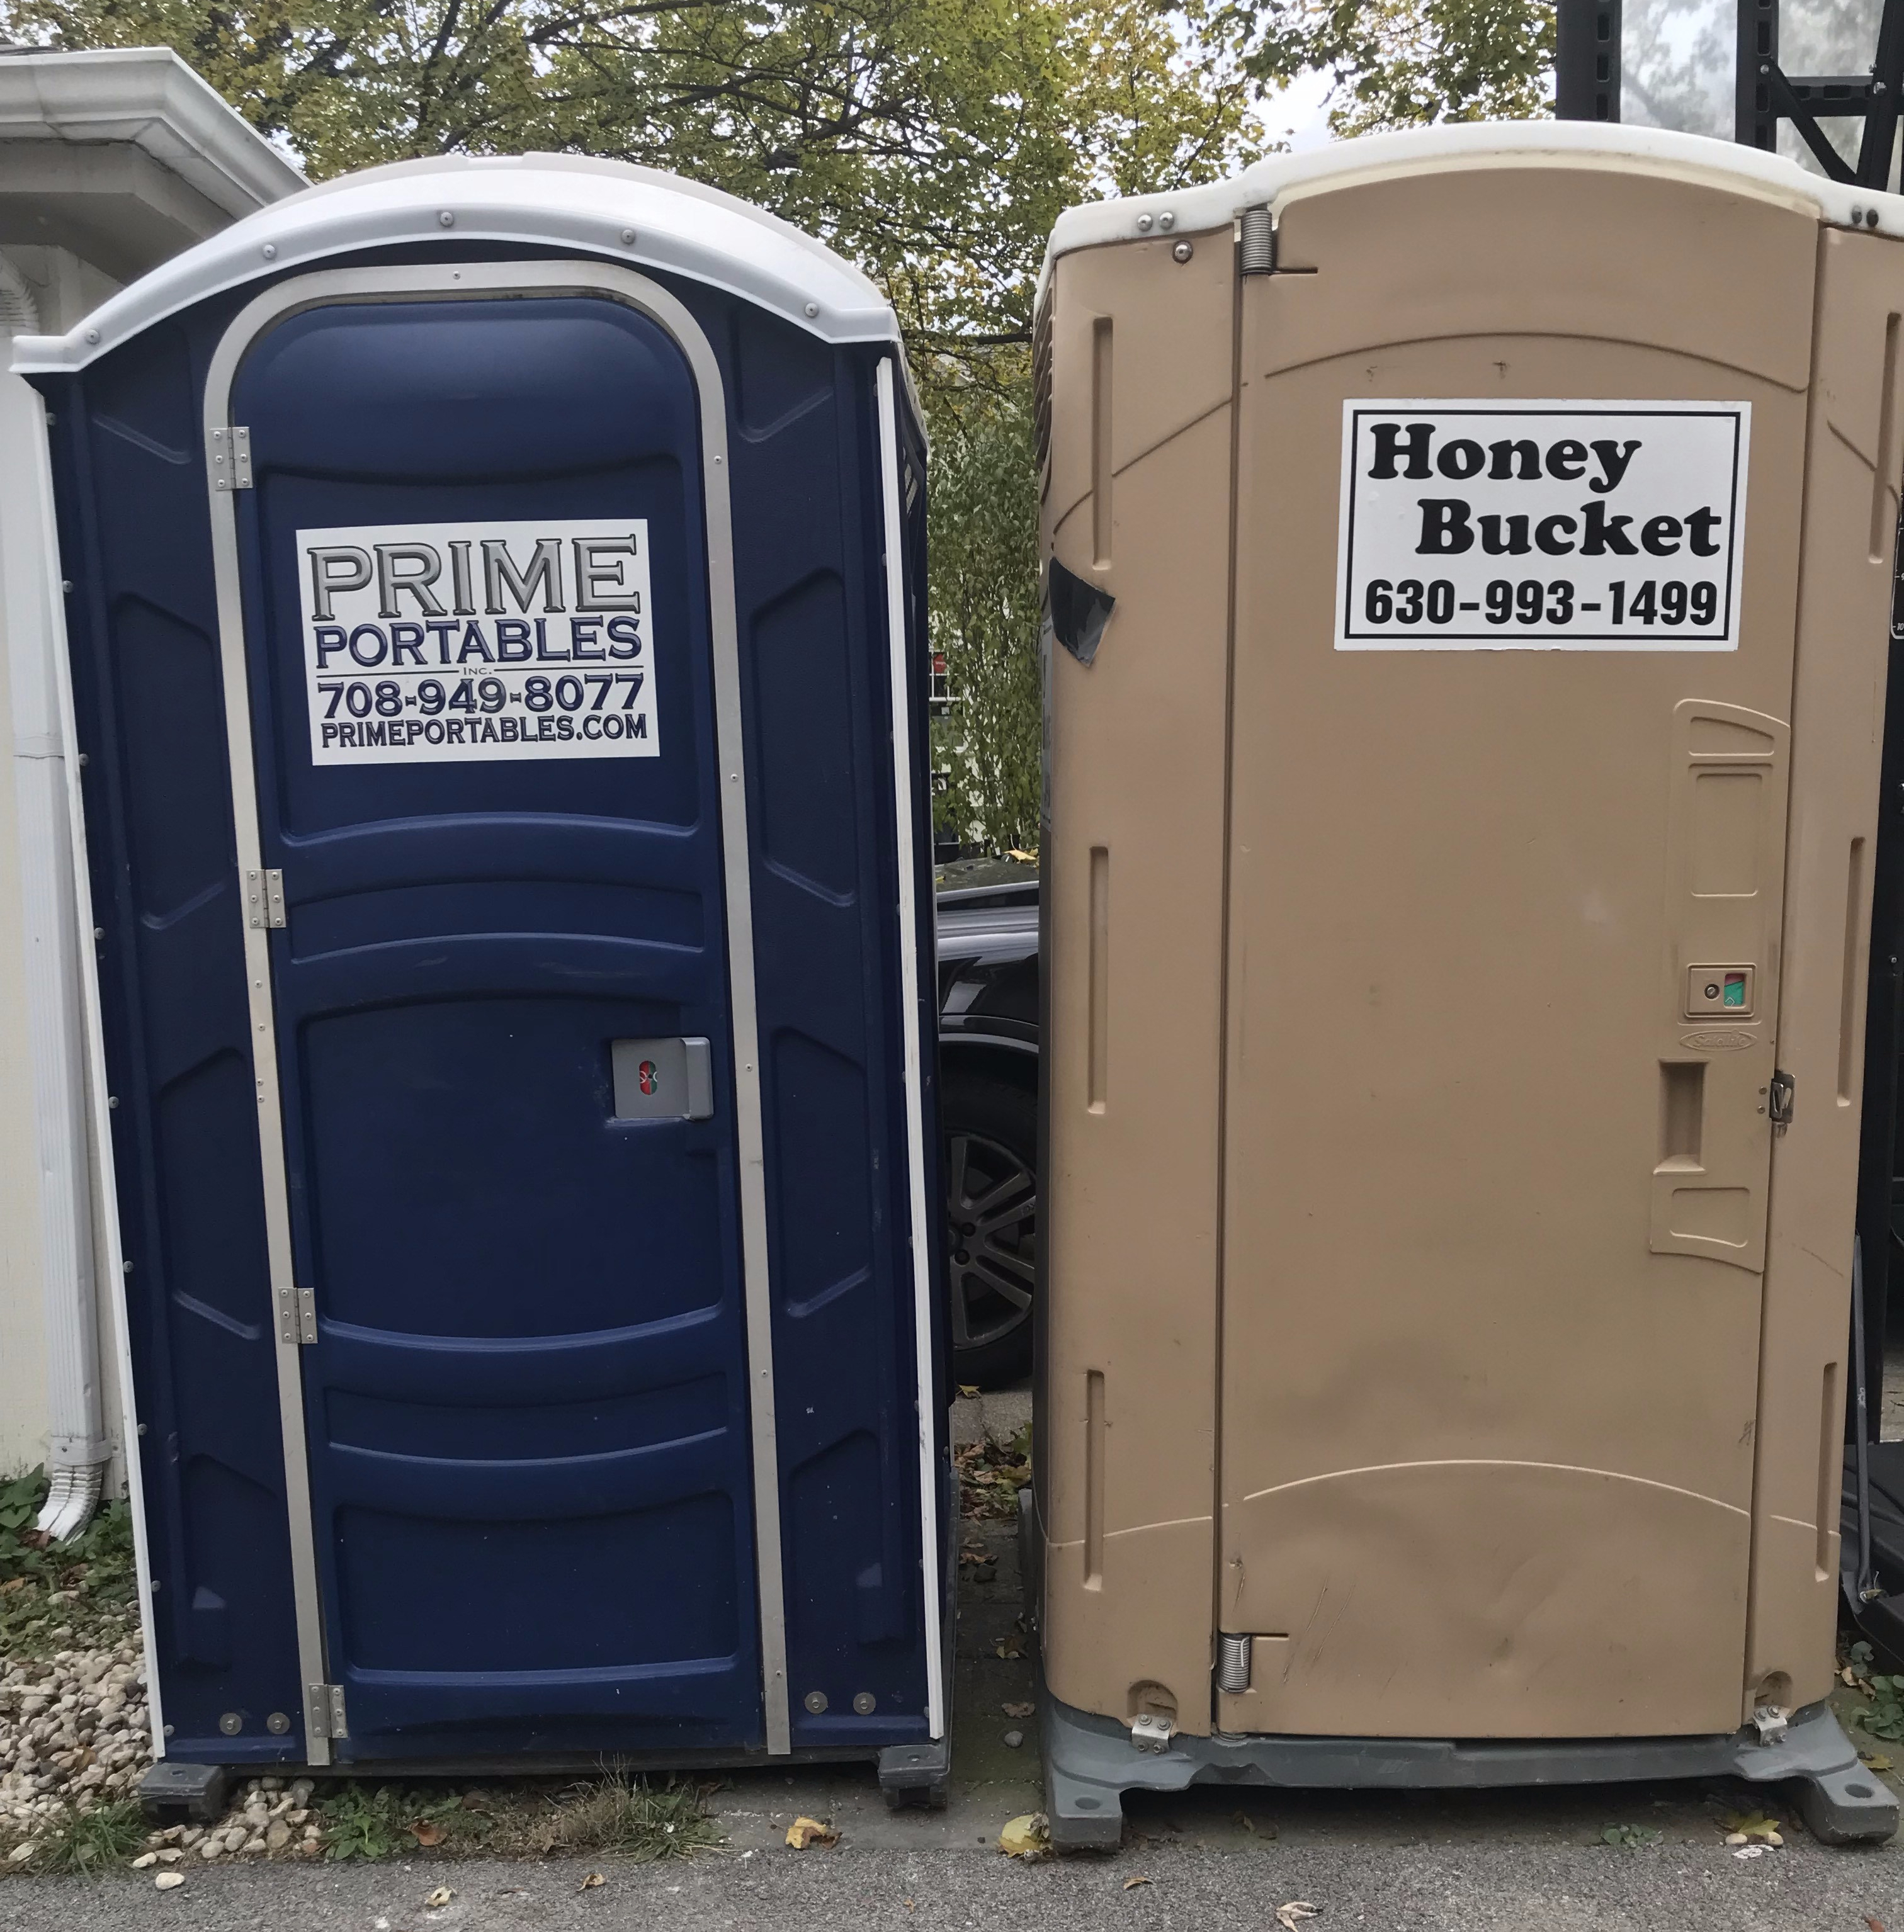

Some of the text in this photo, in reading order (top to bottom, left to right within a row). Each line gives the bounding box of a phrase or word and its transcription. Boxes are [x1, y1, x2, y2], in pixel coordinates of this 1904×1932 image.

[1368, 422, 1642, 494] Honey
[1415, 499, 1722, 556] Bucket
[307, 534, 641, 621] PRIME
[1365, 579, 1718, 625] 630-993-1499
[314, 616, 642, 669] PORTABLES
[318, 672, 644, 719] 708-949-8077
[321, 714, 647, 749] PRIMEPORTABLES.COM
